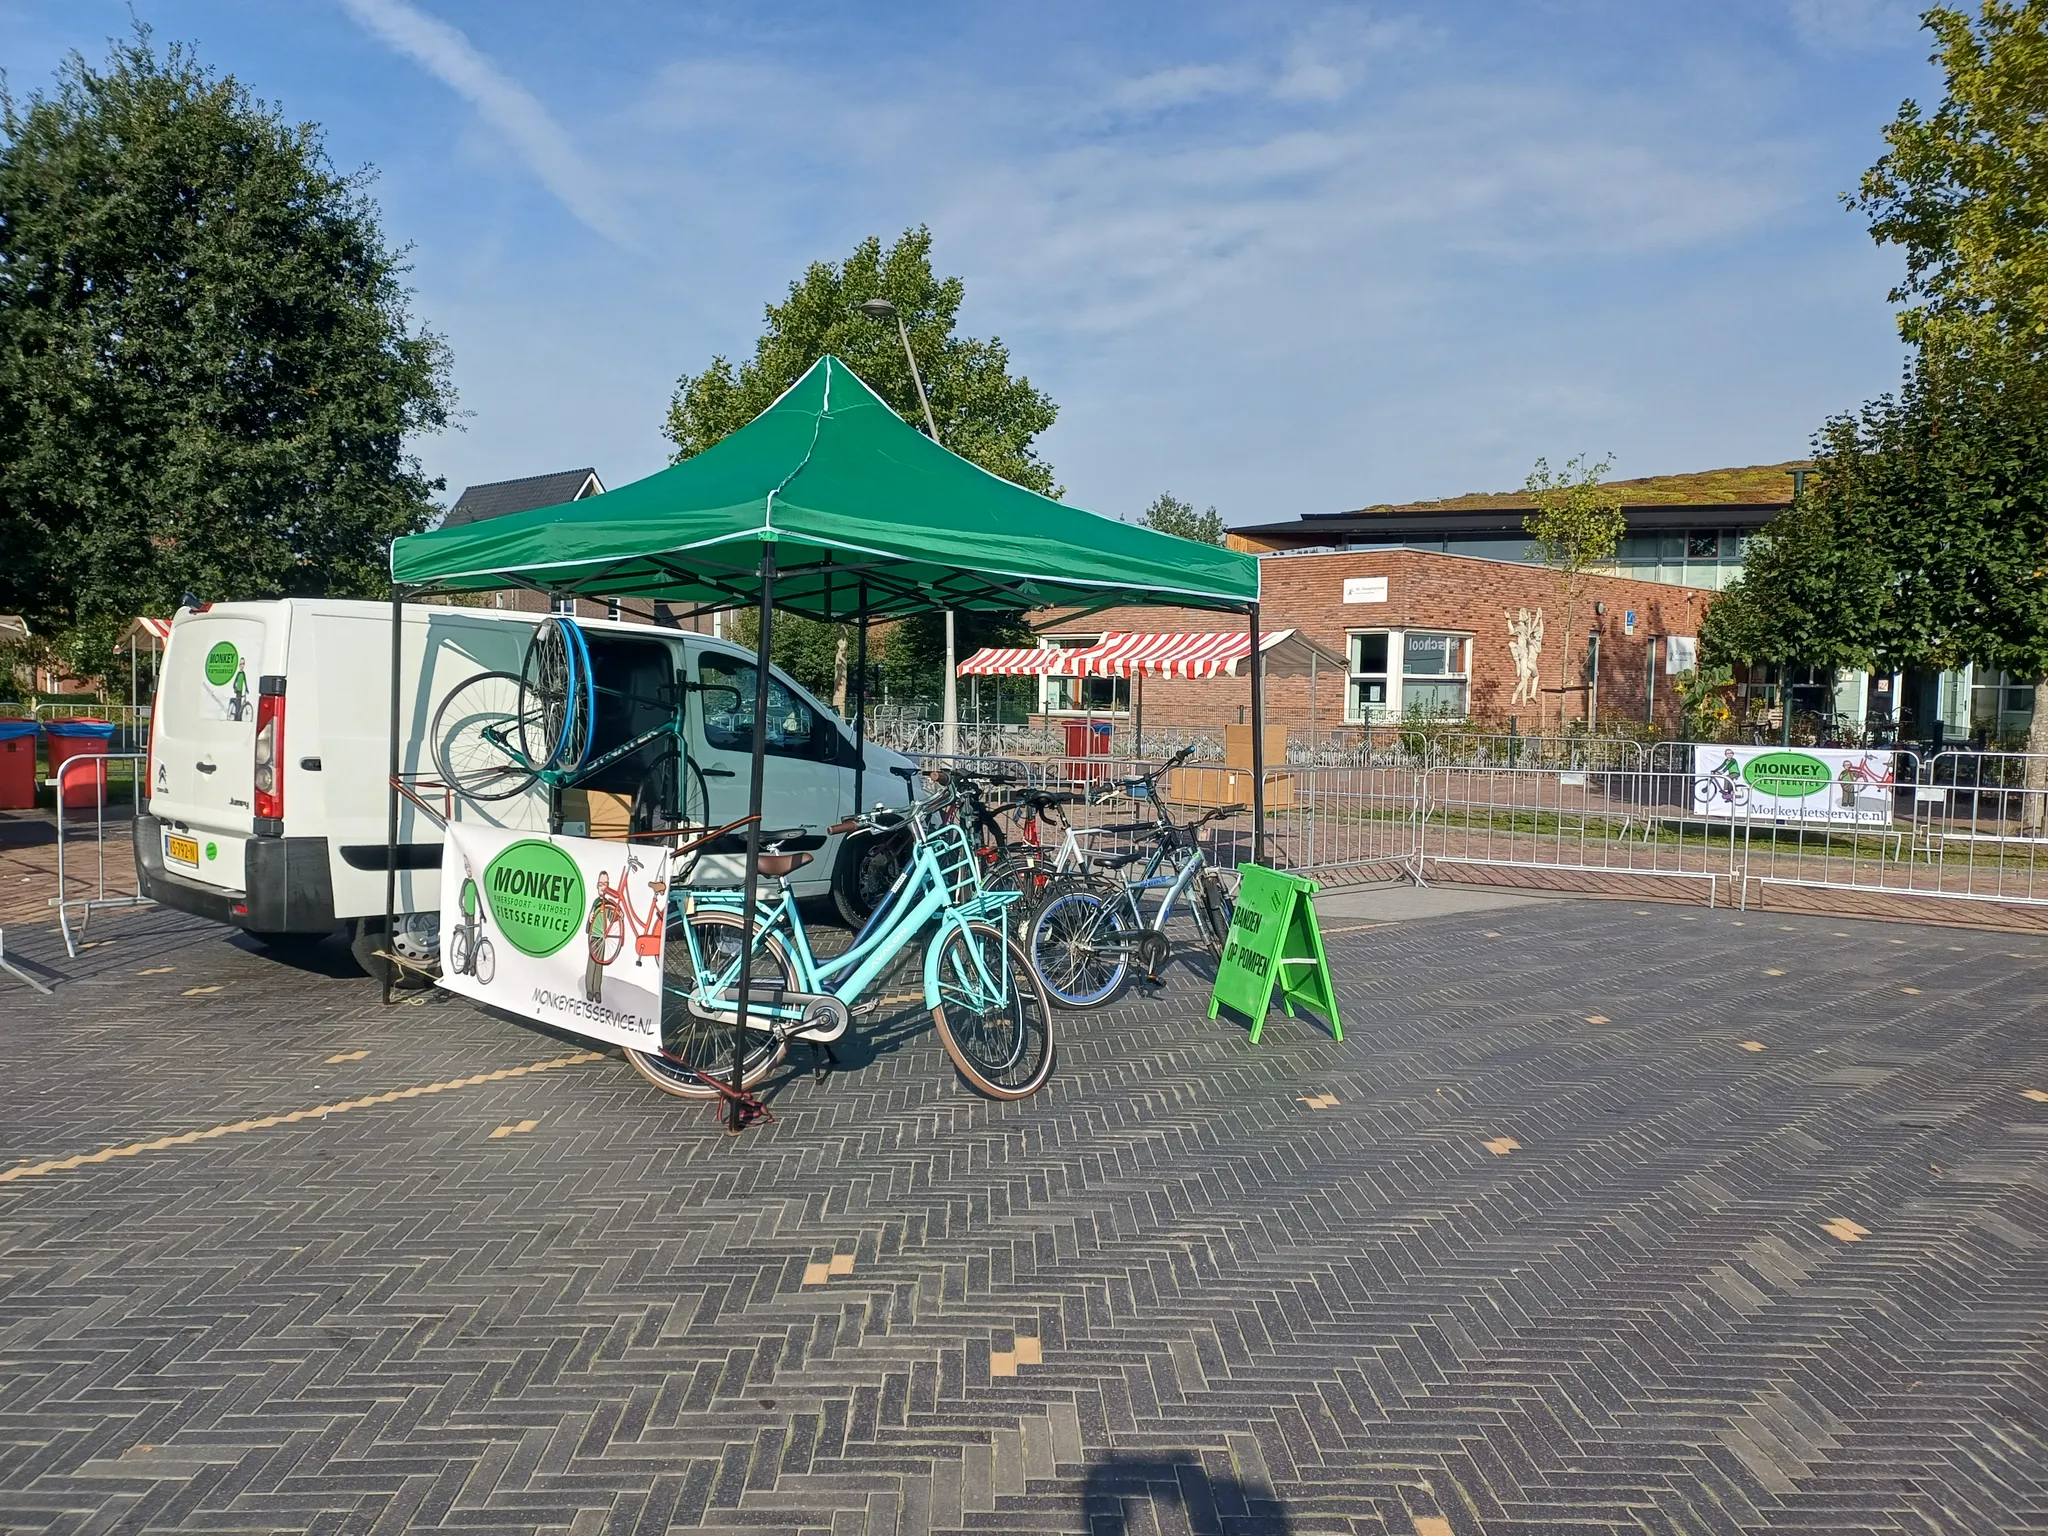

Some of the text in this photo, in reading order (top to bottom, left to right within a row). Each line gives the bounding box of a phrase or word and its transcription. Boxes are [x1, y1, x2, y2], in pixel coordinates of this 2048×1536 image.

[209, 653, 235, 664] MONKEY
[1754, 763, 1820, 776] MONKEY
[493, 866, 576, 904] MONKEY
[496, 905, 569, 933] FIETSSERVICE
[538, 902, 571, 916] VATHORST
[1233, 905, 1263, 934] BANDEN
[871, 927, 908, 970] AVALON
[1226, 942, 1270, 979] OP POMPEN
[532, 987, 655, 1036] MONKEYFIETSSERVICE.NL
